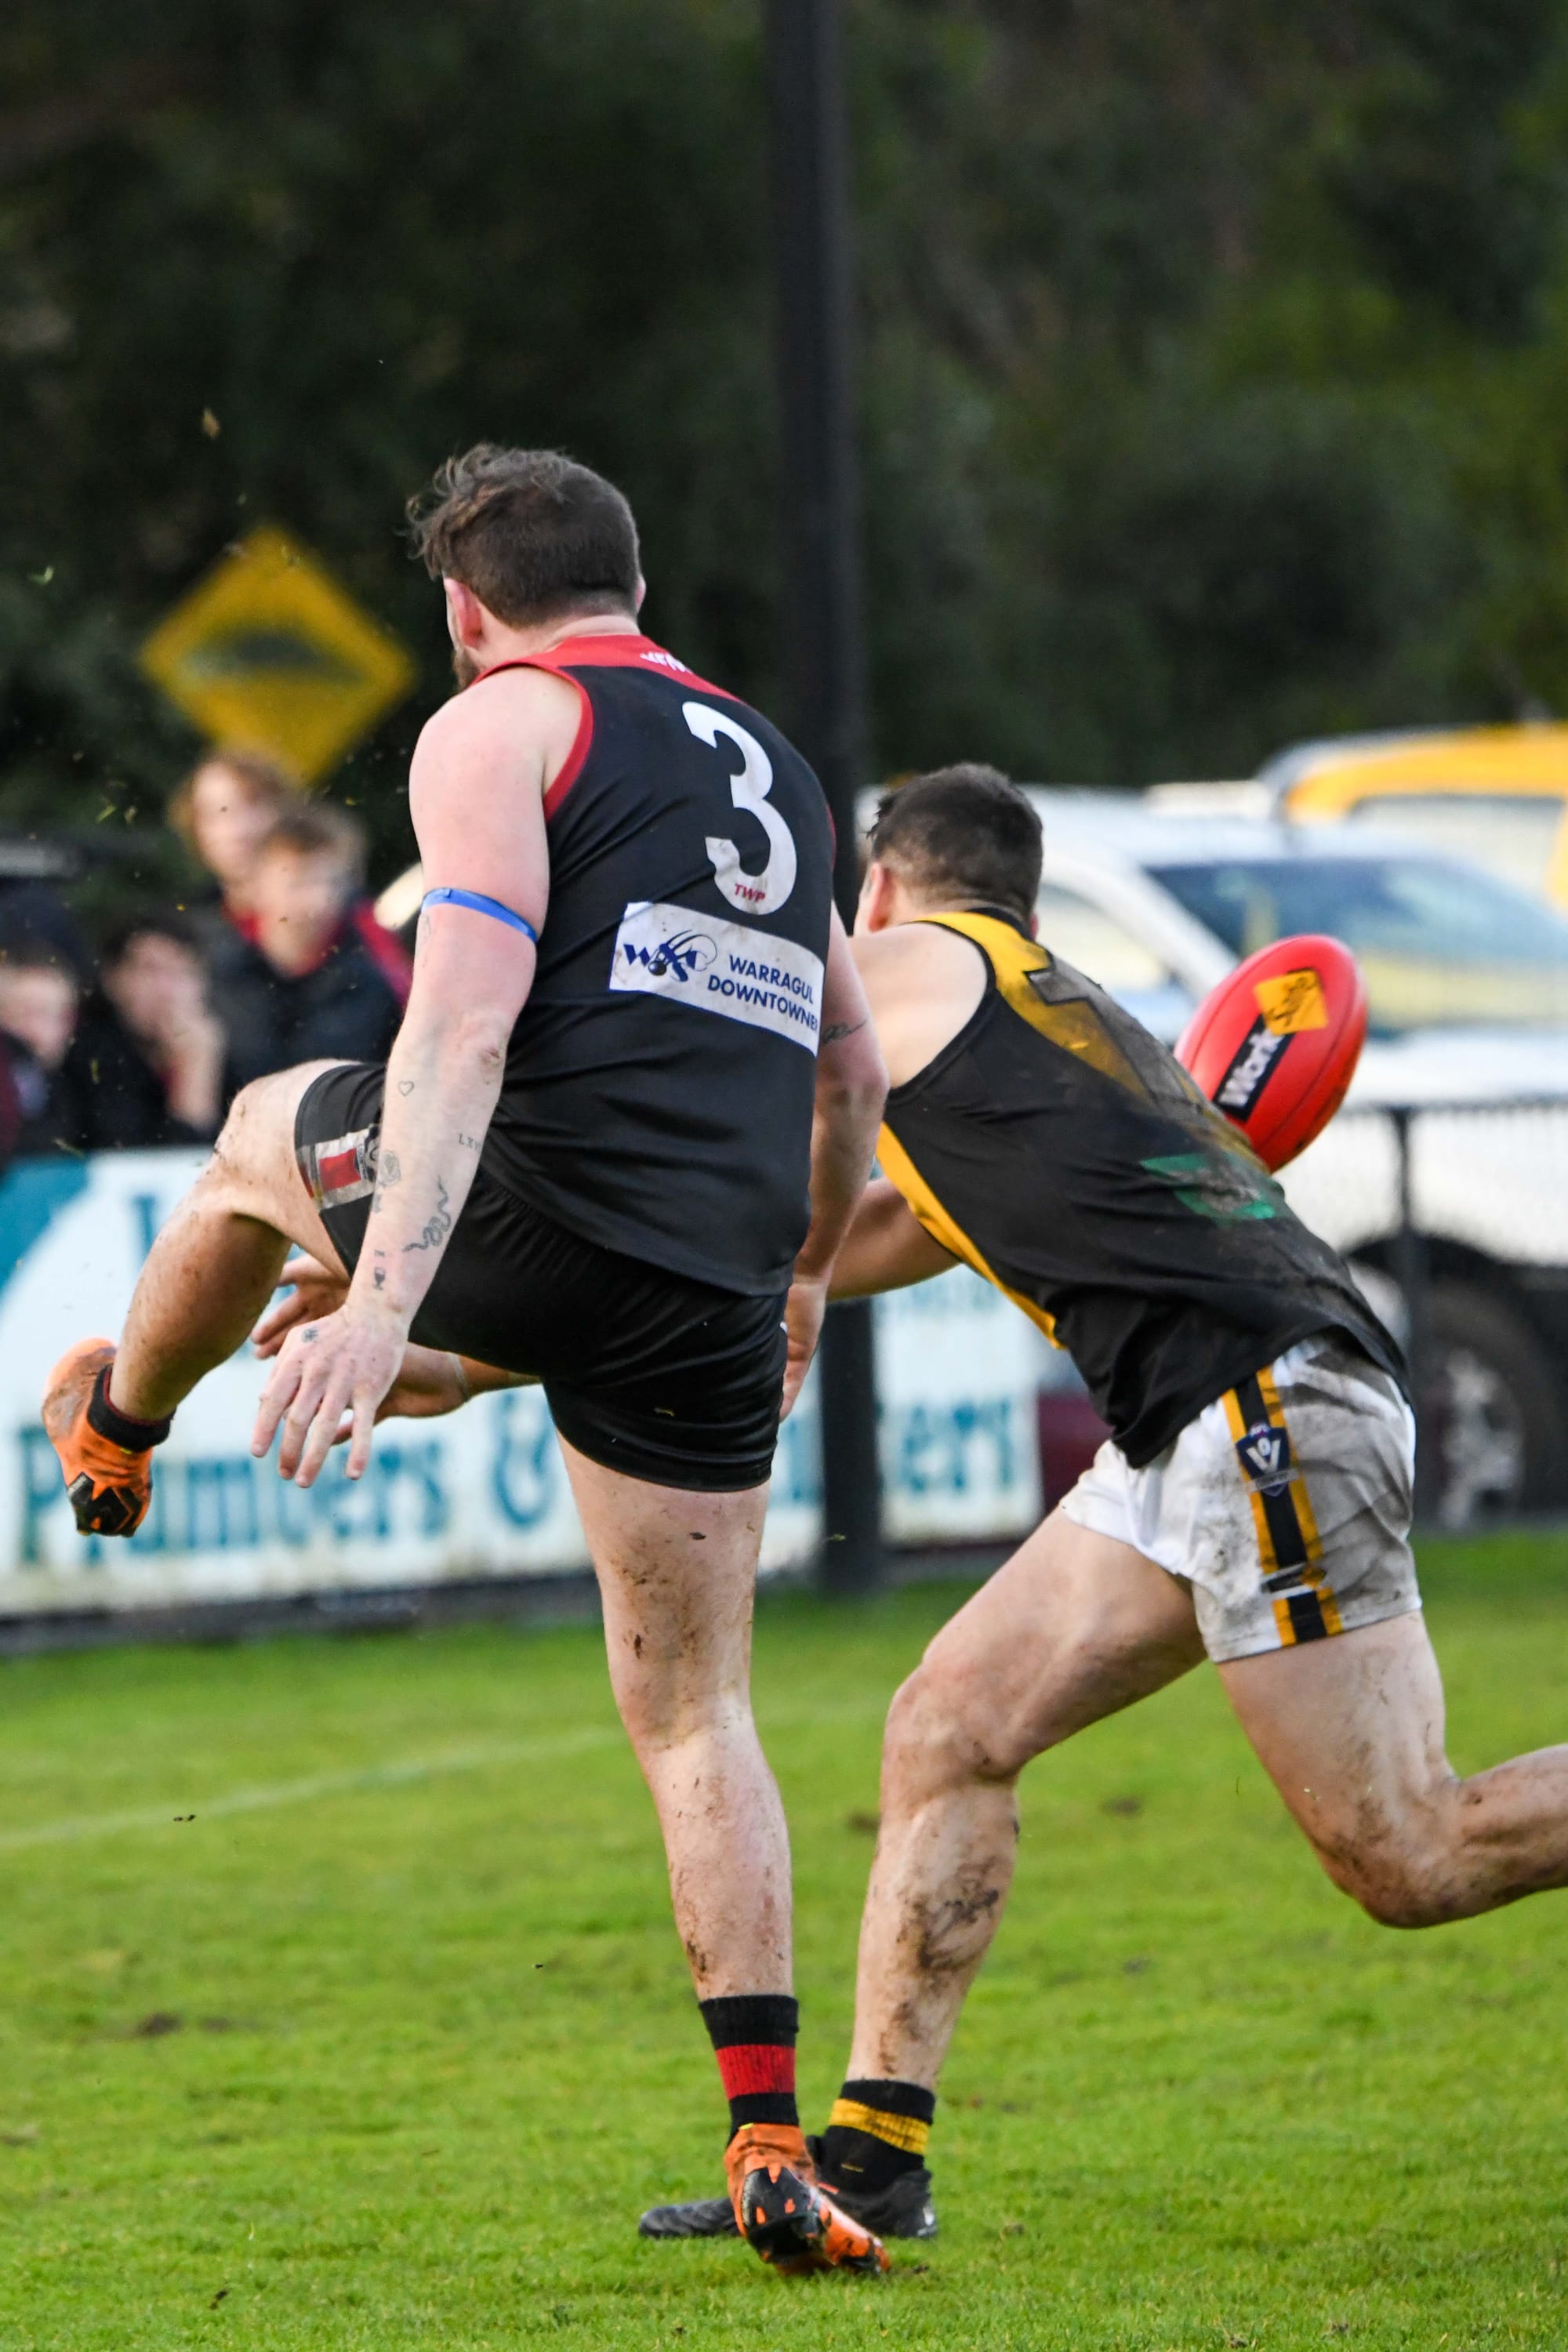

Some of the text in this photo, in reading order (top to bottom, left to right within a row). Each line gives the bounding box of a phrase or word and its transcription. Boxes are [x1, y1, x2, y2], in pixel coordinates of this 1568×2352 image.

[681, 701, 797, 916] 3
[735, 882, 766, 902] TWP
[728, 953, 814, 1004] WARRAGUL
